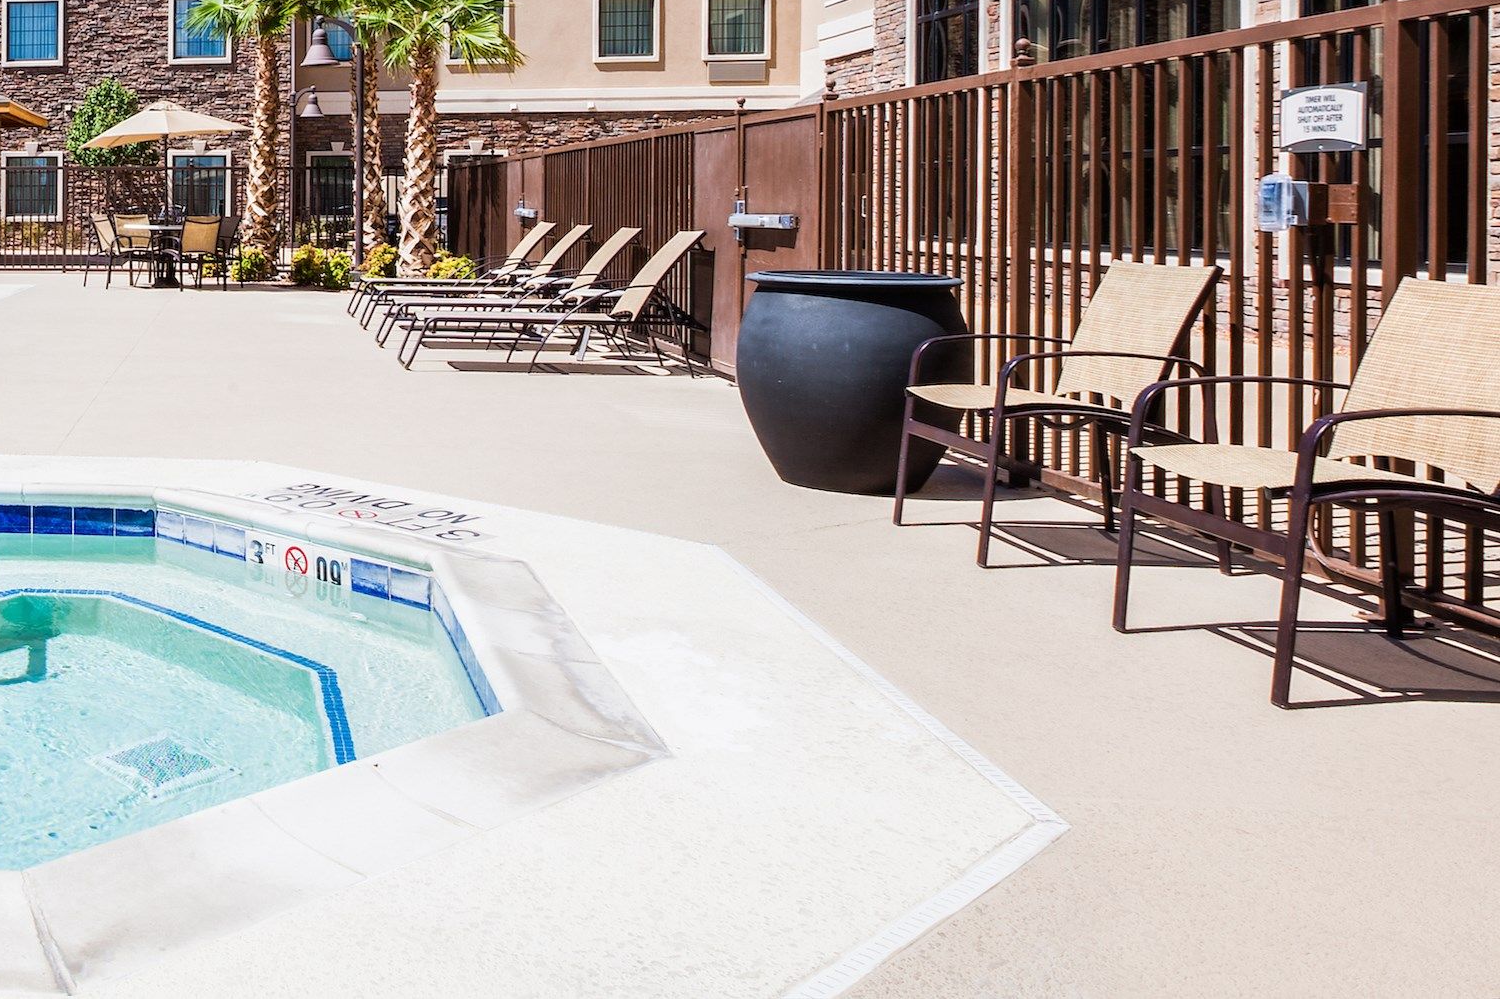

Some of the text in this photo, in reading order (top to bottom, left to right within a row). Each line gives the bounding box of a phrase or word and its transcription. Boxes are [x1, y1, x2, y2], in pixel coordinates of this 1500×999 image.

[1305, 95, 1322, 103] TIMER
[1297, 104, 1344, 114] AUTOMATICALLY
[1297, 114, 1343, 124] SHUT OFF AFTER
[1312, 124, 1337, 133] MINUTES
[287, 483, 481, 524] NO DIVING
